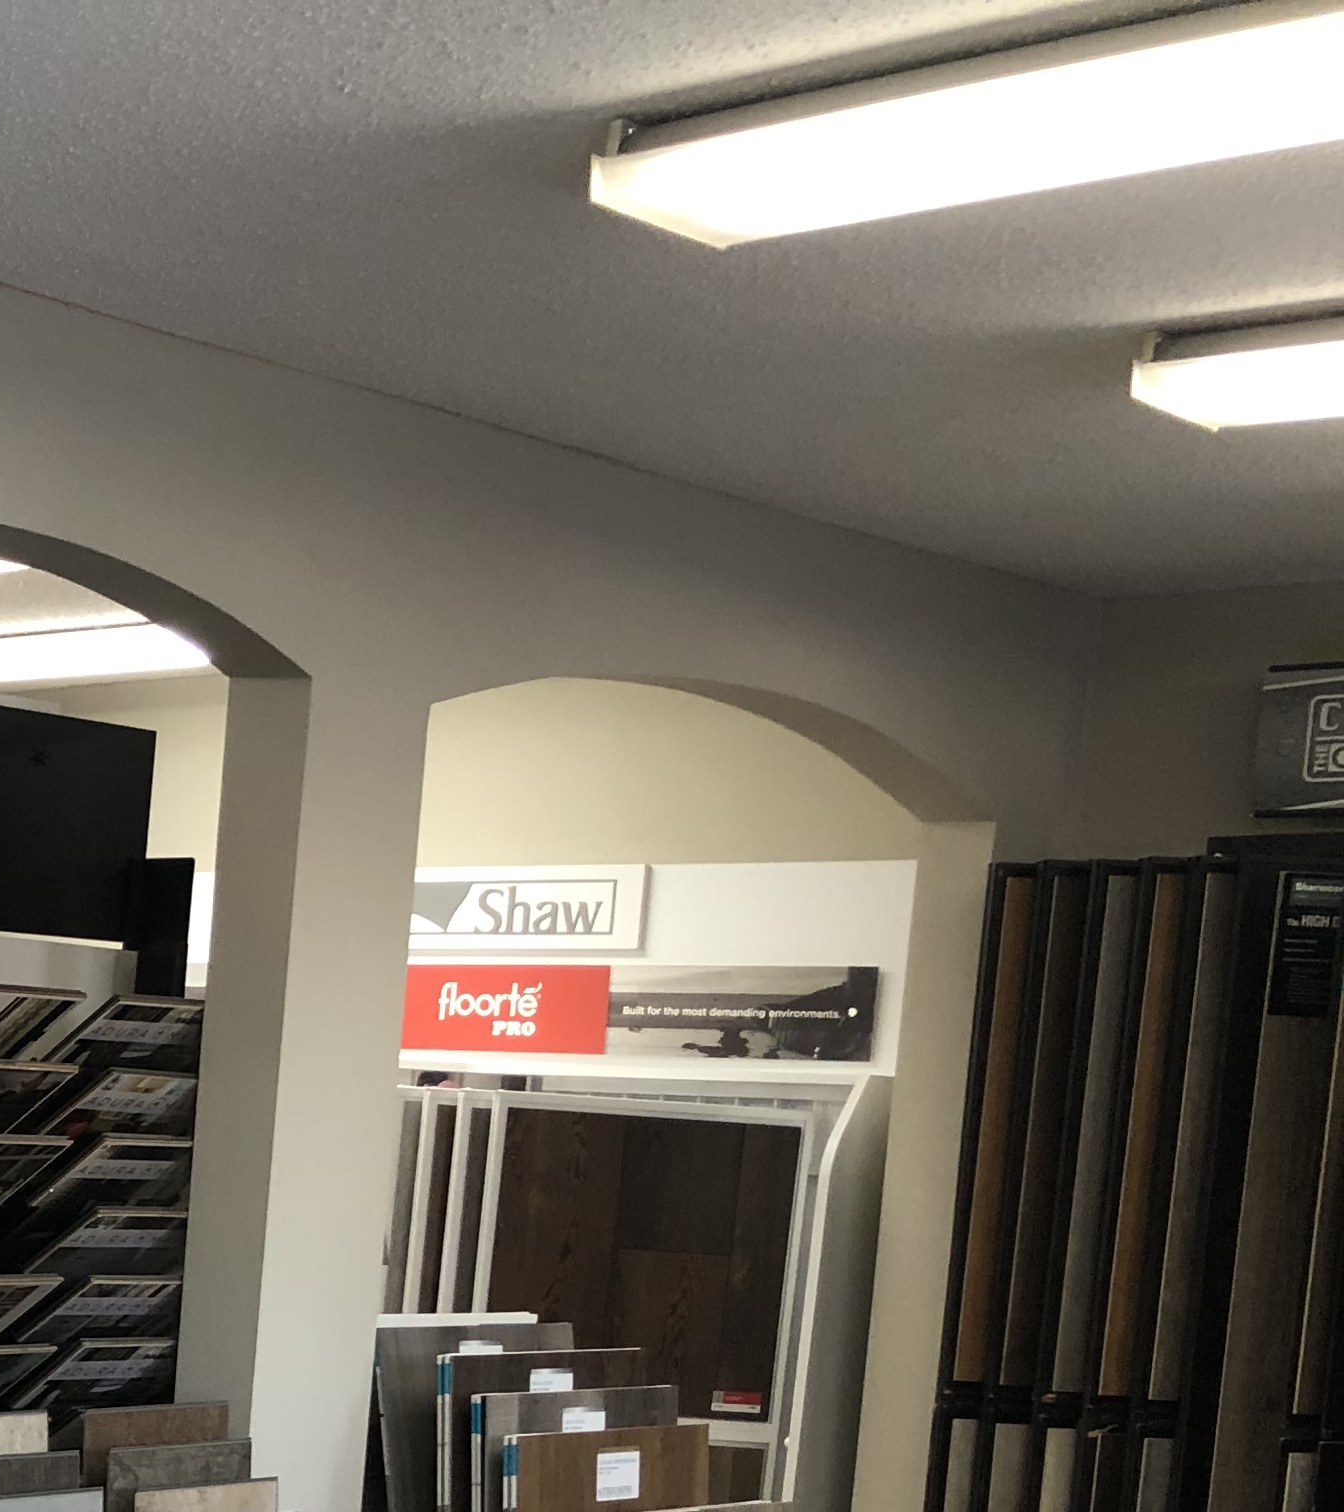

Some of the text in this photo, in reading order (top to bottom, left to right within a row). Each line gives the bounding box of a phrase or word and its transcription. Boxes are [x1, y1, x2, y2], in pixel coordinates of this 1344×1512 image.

[473, 885, 604, 935] Shaw
[438, 982, 543, 1021] floorté
[622, 1005, 645, 1016] Built
[647, 1005, 662, 1016] for
[664, 1005, 680, 1017] the
[682, 1006, 707, 1017] most
[709, 1006, 766, 1020] demanding
[491, 1020, 537, 1037] PRO
